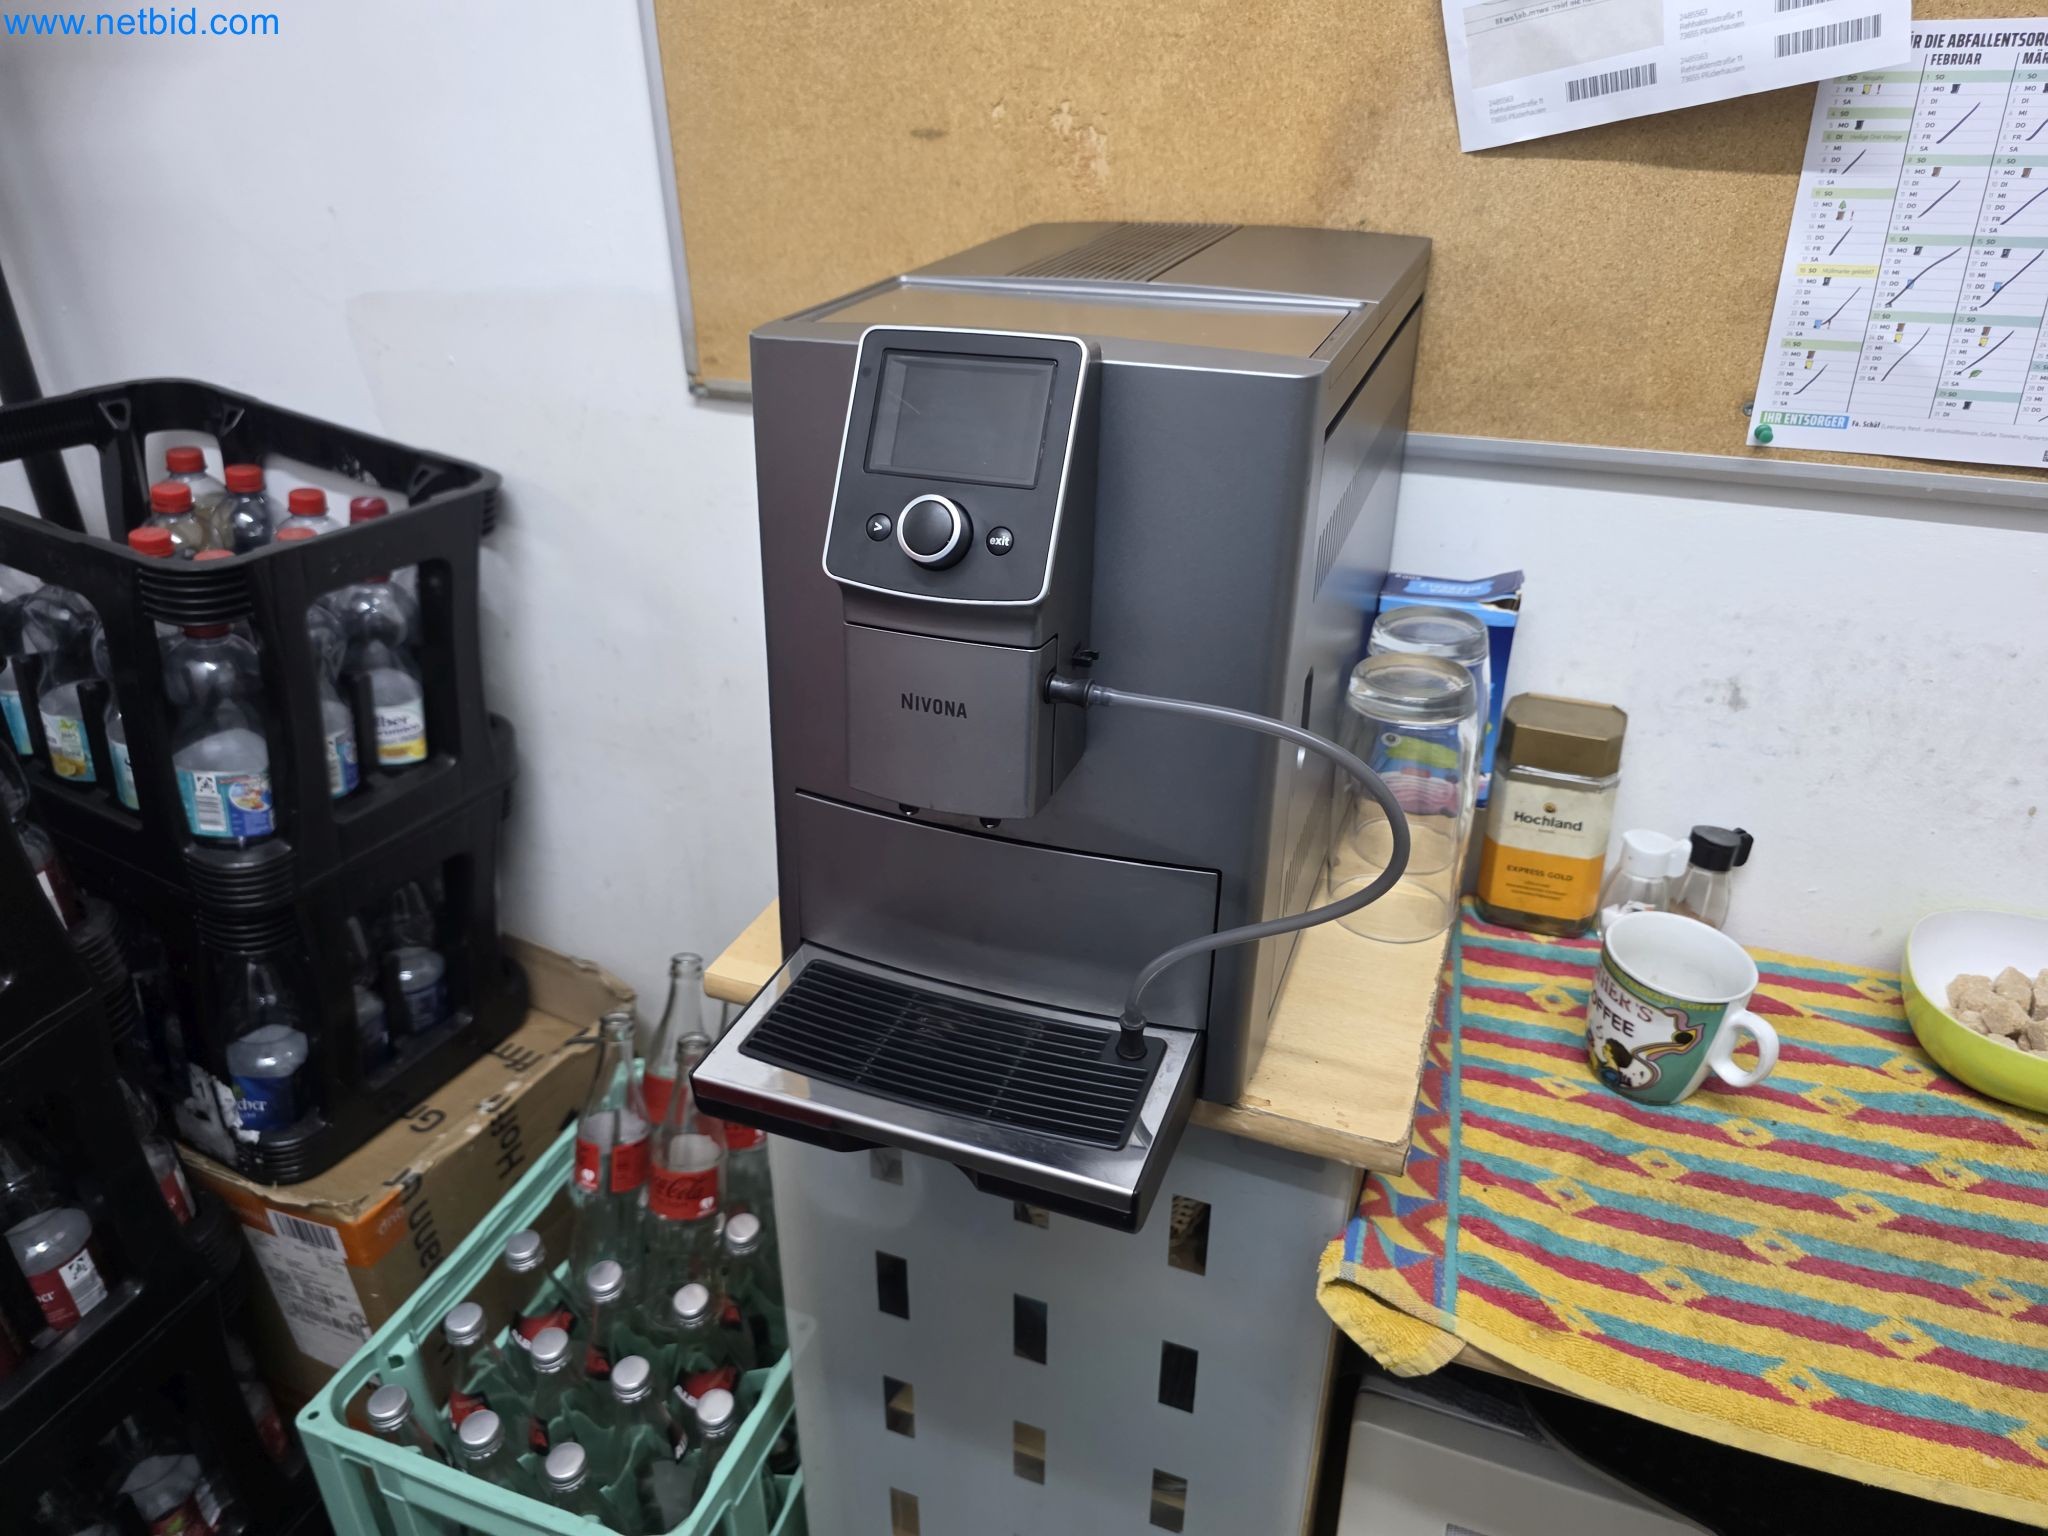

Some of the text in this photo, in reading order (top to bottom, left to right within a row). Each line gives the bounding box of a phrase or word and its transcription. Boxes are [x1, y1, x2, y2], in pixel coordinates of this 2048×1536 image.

[1924, 34, 1946, 48] DIE
[1930, 53, 1982, 66] FEBRUAR
[1763, 412, 1782, 424] IHR
[1784, 414, 1847, 428] ENTSORGER
[989, 536, 1010, 546] exit
[901, 692, 968, 720] NIVONA
[1513, 810, 1584, 832] Hochland
[1506, 864, 1574, 882] EXPRESS GOLD
